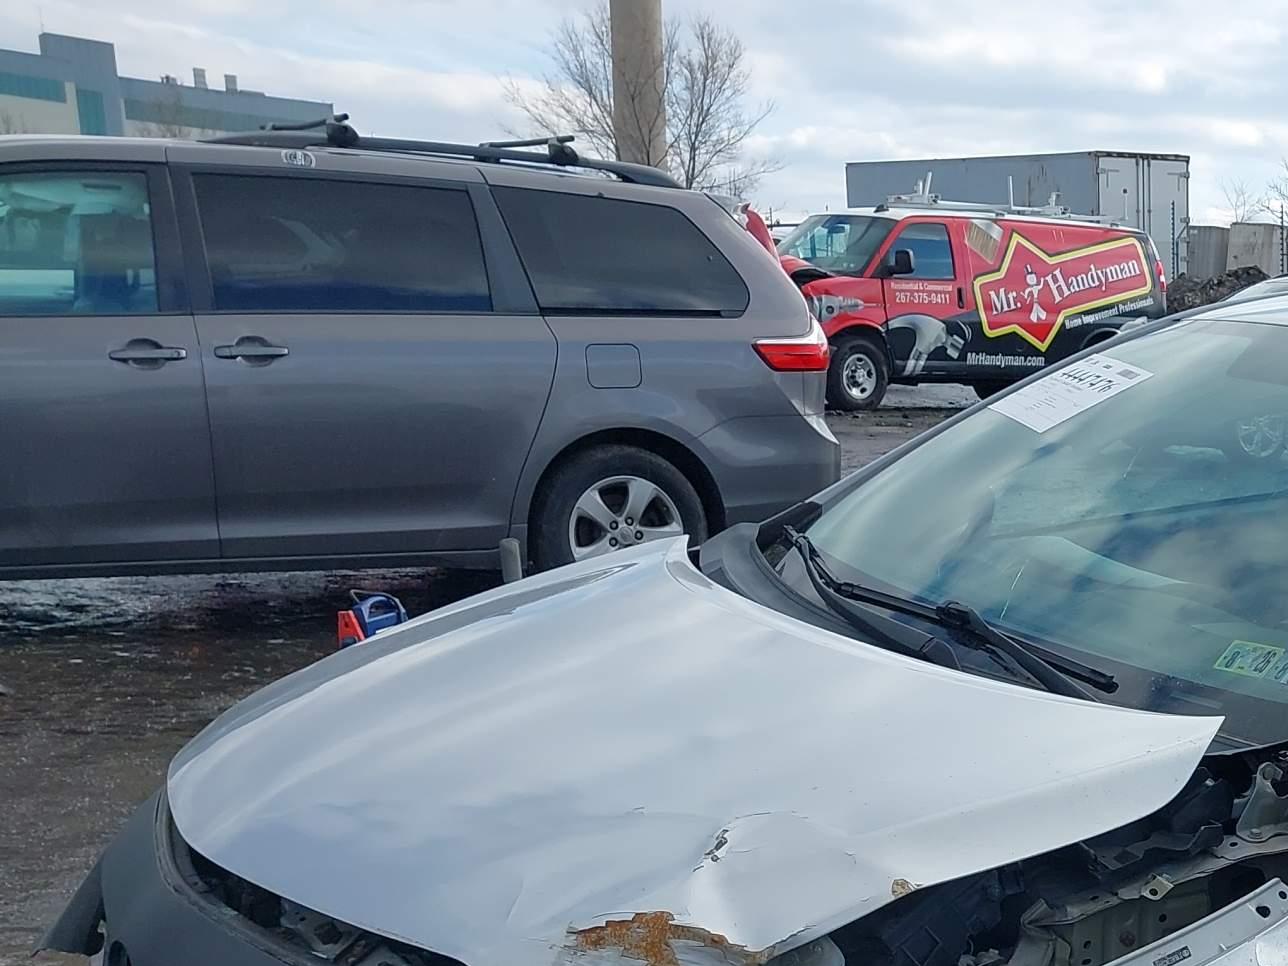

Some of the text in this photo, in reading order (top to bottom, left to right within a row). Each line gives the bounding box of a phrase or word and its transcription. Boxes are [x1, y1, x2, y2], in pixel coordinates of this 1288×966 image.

[895, 291, 951, 304] 267-375-9411
[988, 259, 1141, 315] Mr. Handyman
[1064, 295, 1154, 330] Home Improvement Professionals
[966, 351, 1046, 369] MrHandyman.com
